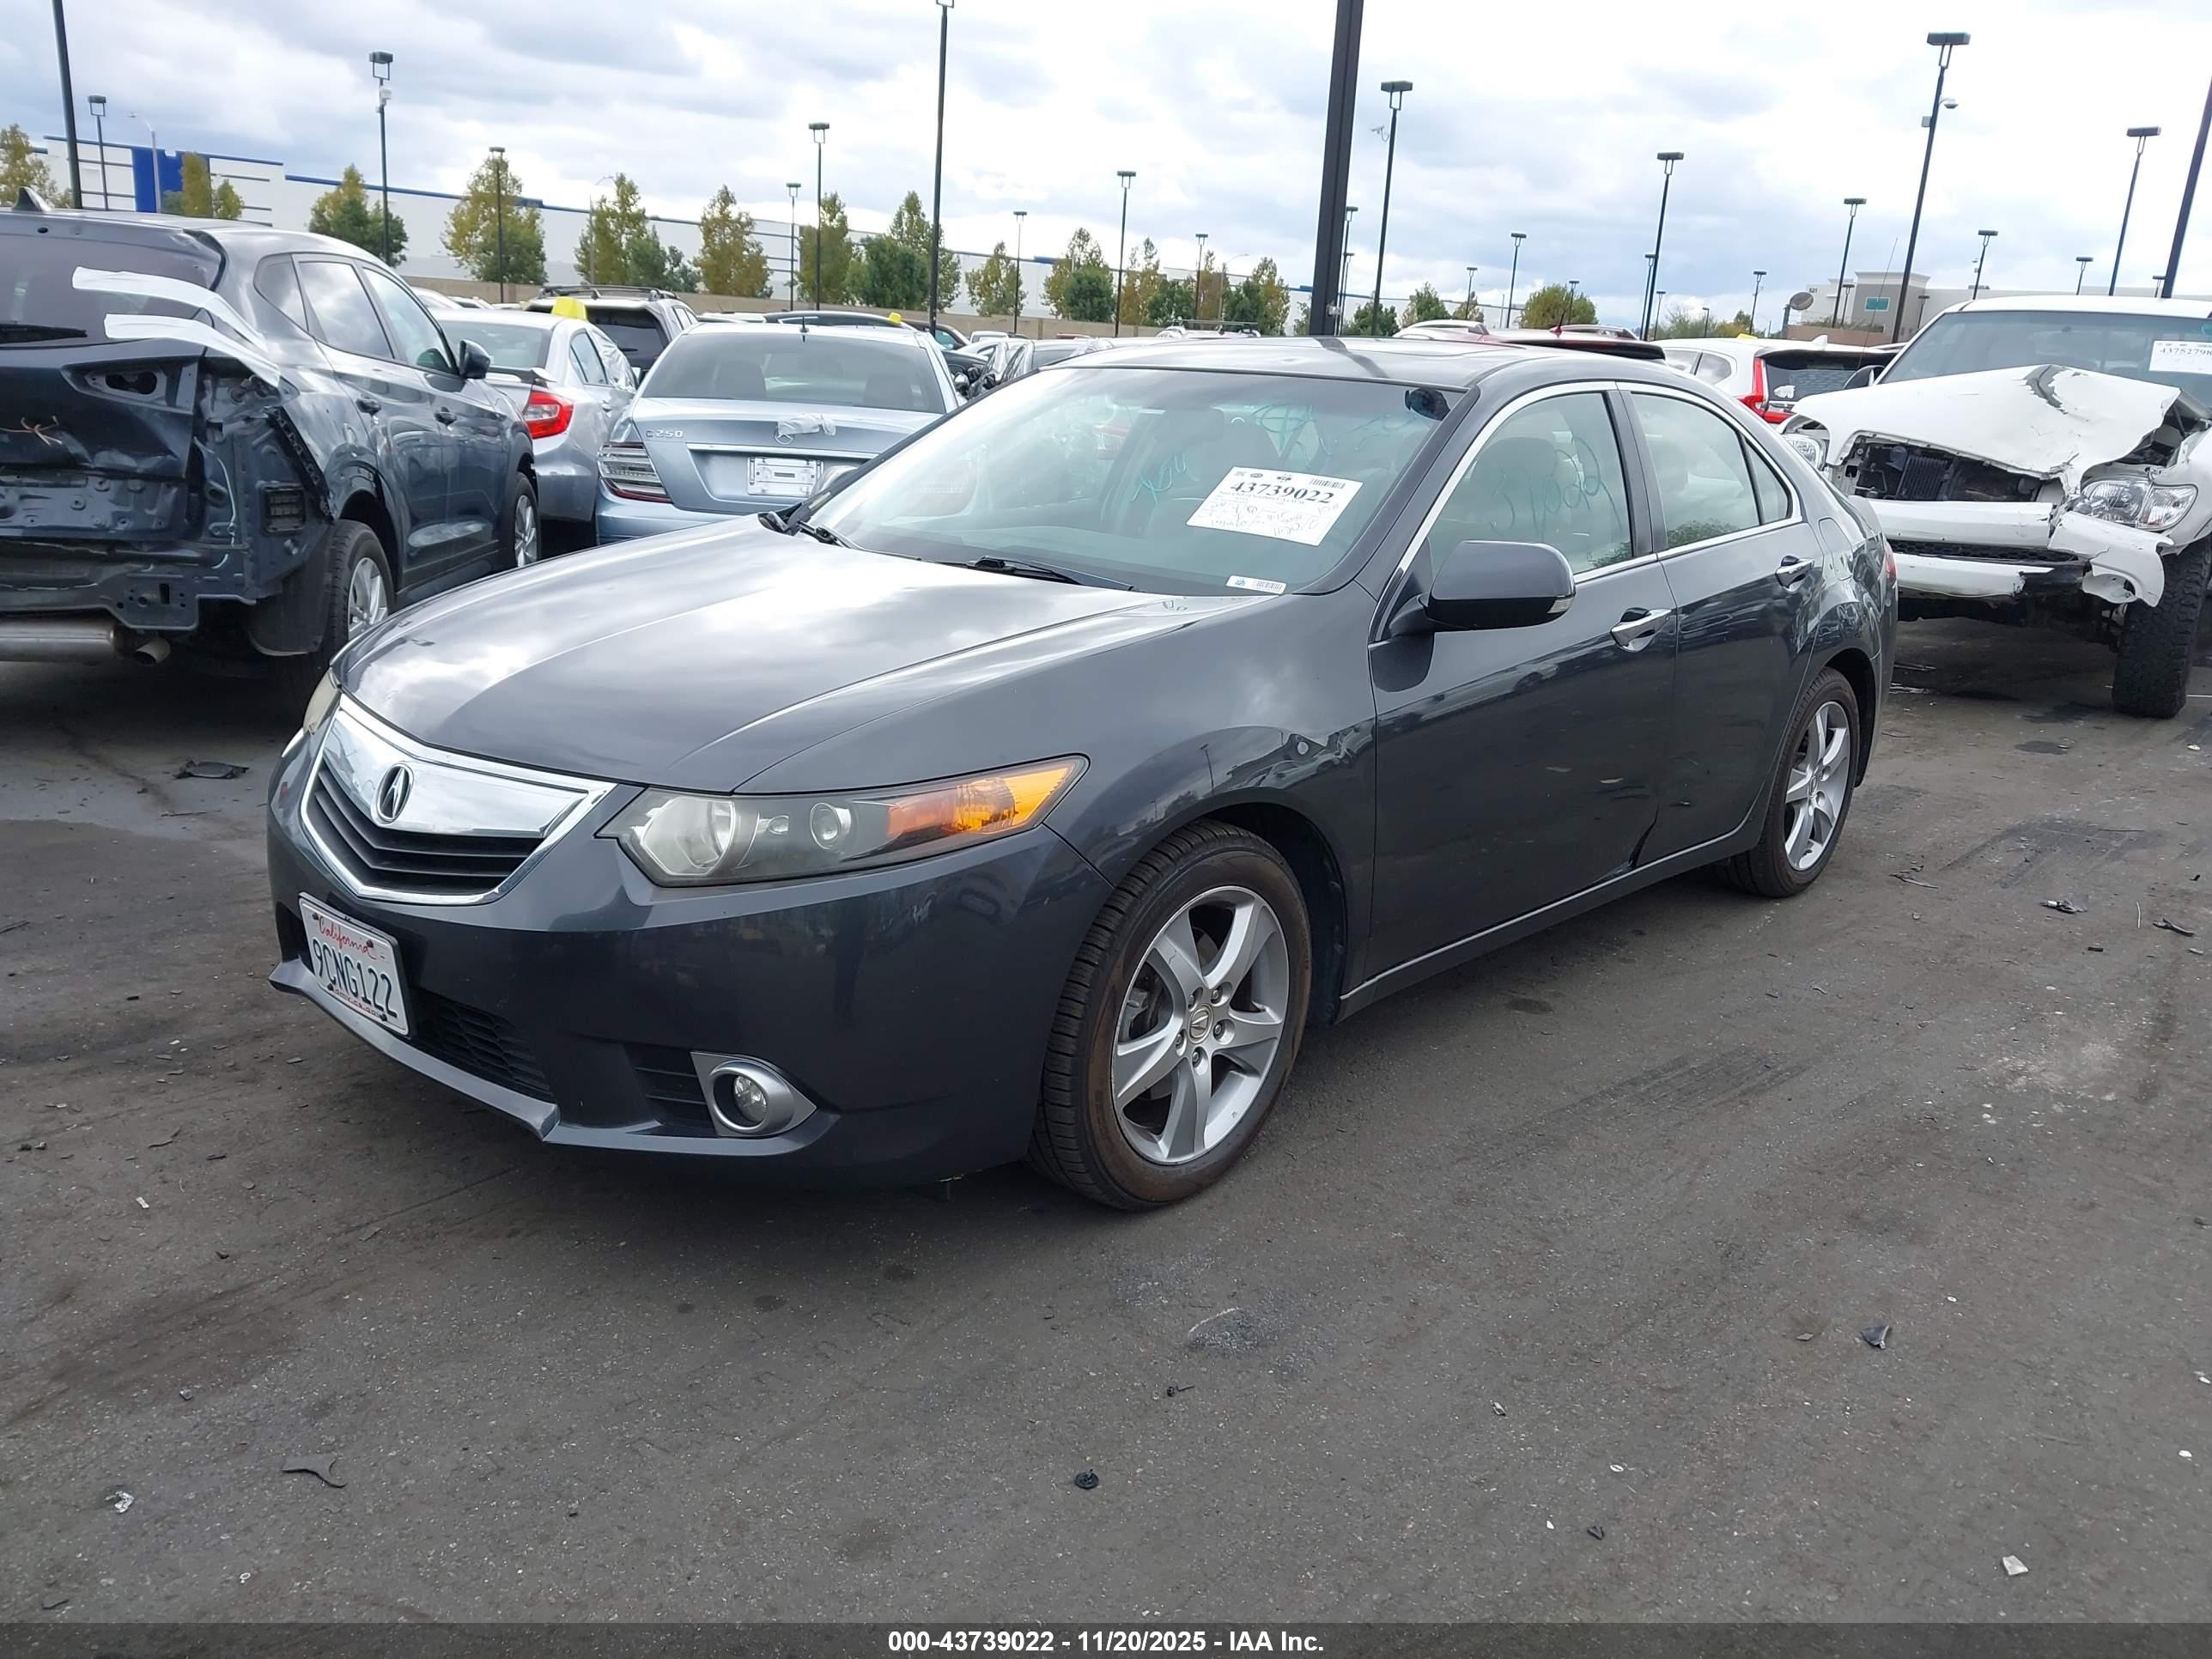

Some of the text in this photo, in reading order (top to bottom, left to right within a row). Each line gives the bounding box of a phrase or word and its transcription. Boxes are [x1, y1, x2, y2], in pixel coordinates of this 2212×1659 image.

[1231, 481, 1334, 504] 43739022
[319, 916, 376, 959] California
[313, 939, 398, 1018] 9CNG122
